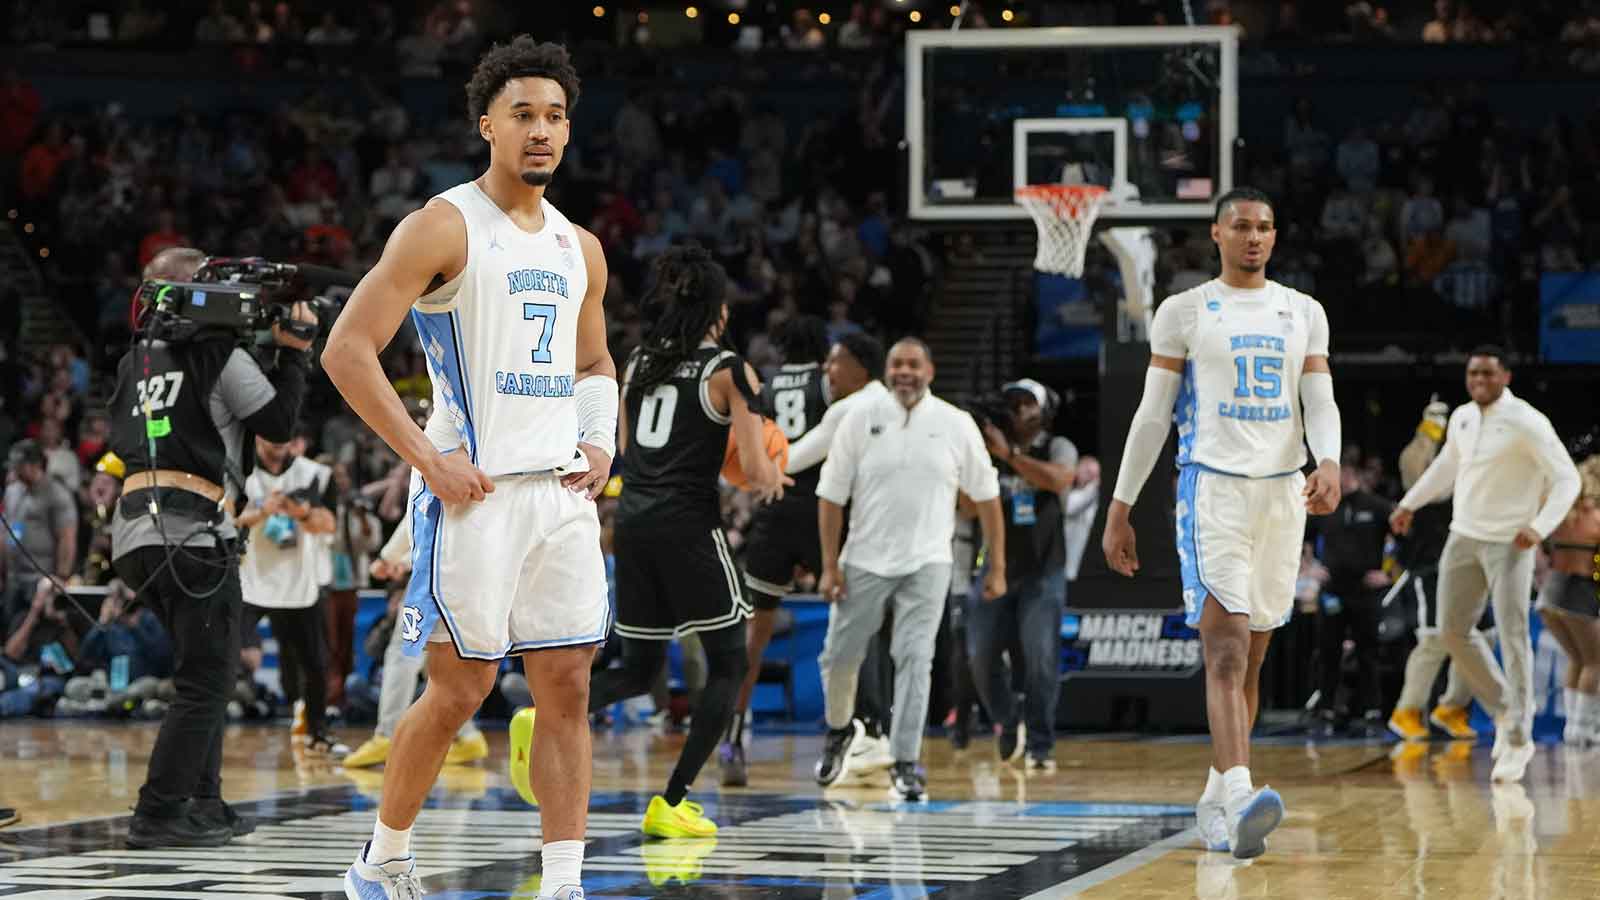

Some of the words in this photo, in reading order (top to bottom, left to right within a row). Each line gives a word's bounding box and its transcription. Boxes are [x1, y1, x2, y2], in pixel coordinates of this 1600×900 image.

[507, 268, 569, 299] NORTH
[523, 303, 557, 364] 7
[1229, 334, 1286, 353] NORTH
[495, 370, 575, 398] CAROLIN
[1234, 355, 1284, 399] 15
[636, 384, 679, 449] 0
[774, 389, 807, 440] 8
[1217, 401, 1292, 422] CAROLINA
[1078, 613, 1165, 641] MARCH
[1088, 640, 1201, 667] MADNESS
